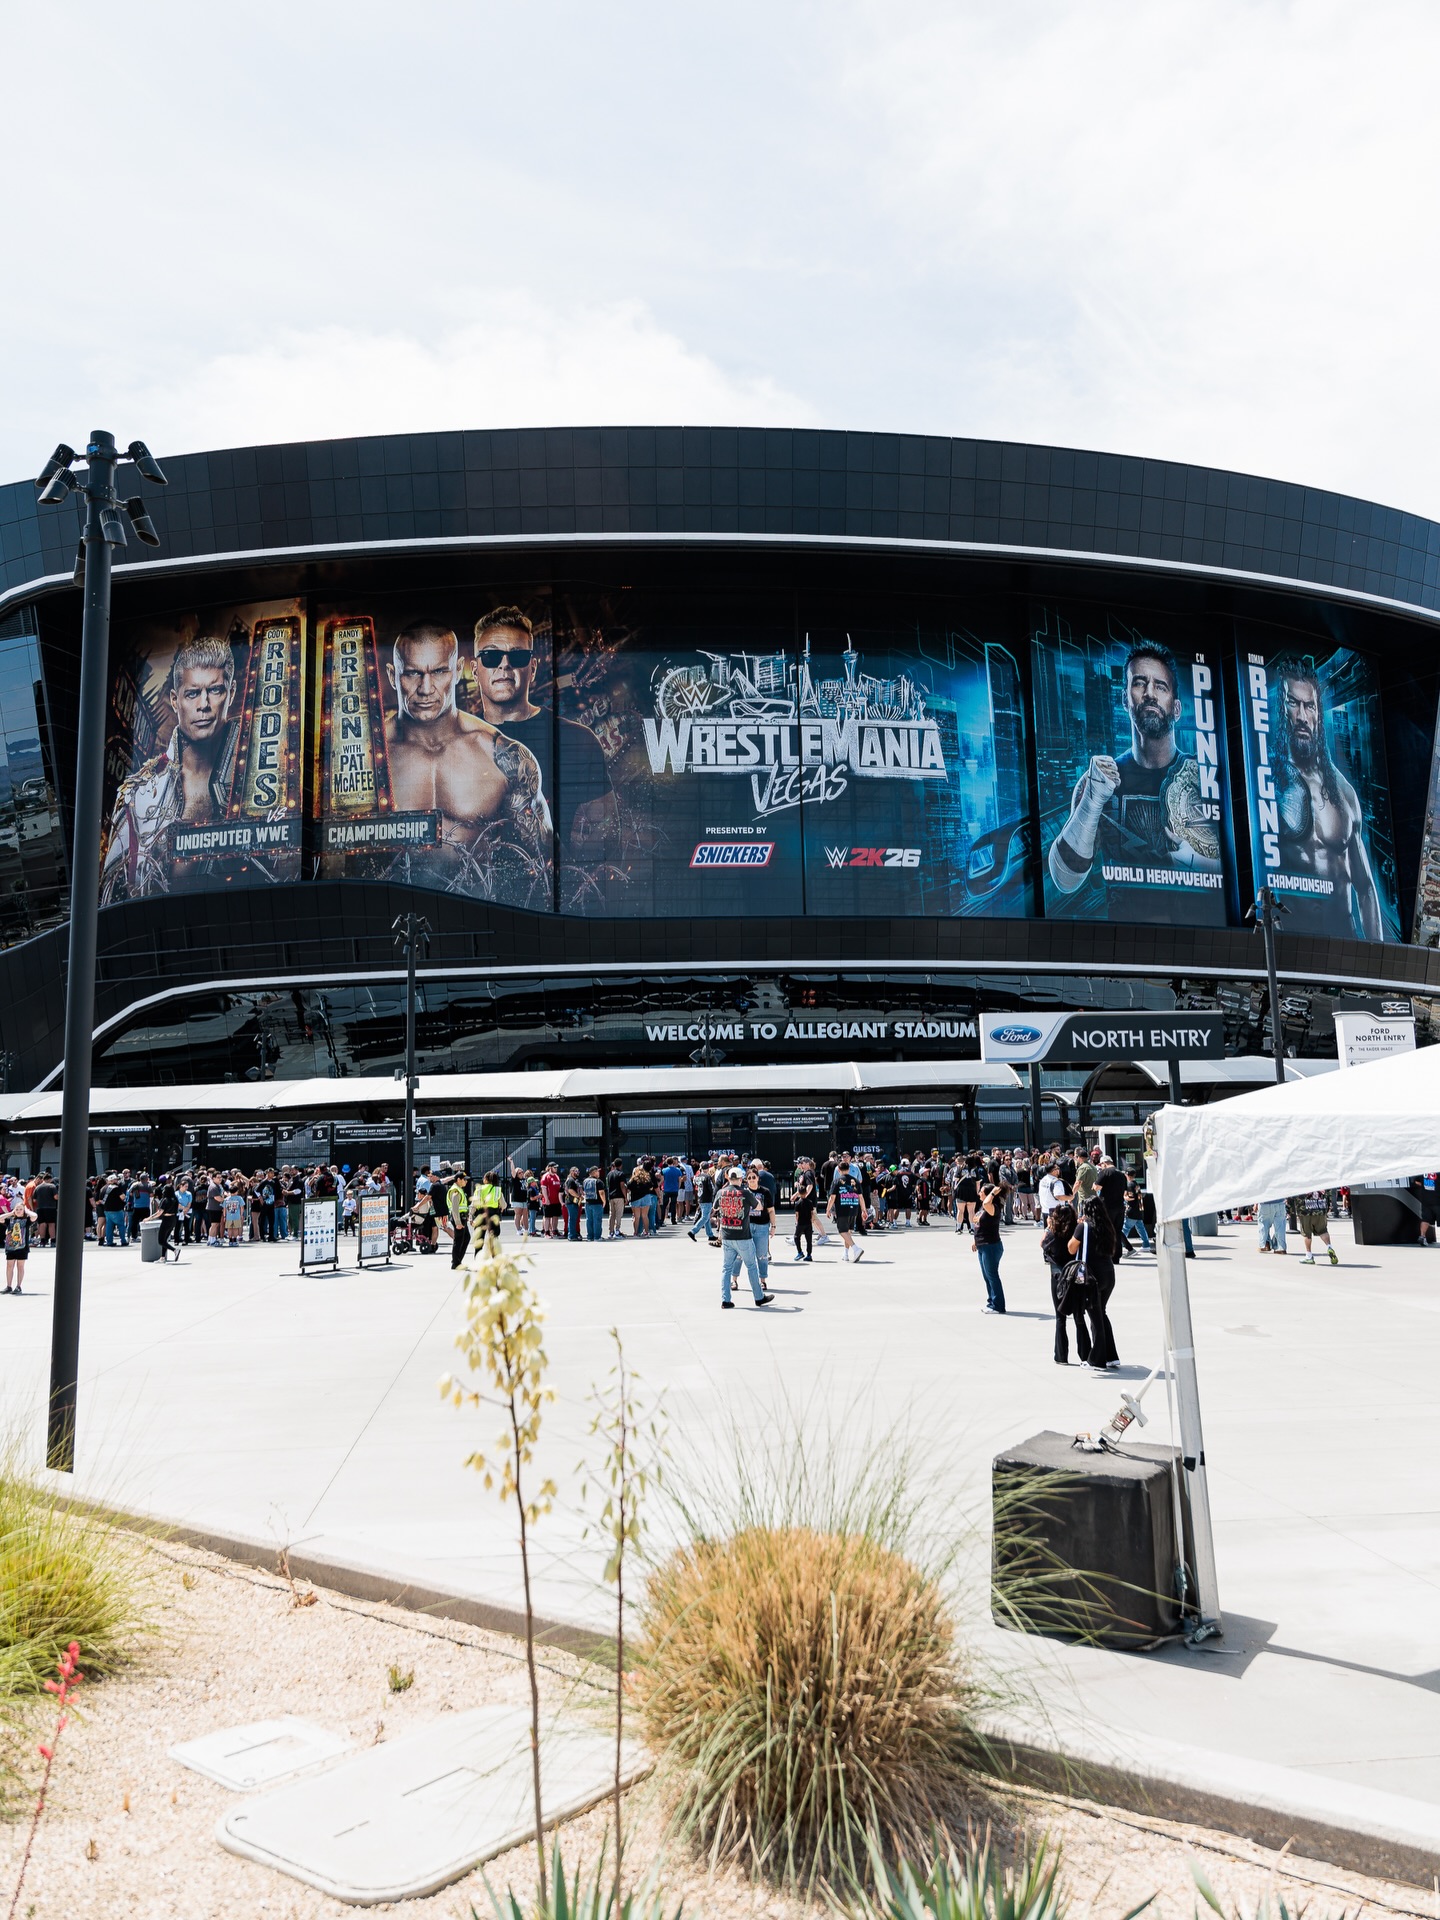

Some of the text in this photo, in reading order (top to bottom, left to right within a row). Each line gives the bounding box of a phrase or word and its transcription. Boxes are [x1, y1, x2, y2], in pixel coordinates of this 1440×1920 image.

[267, 629, 285, 639] CODY
[338, 629, 360, 639] RANDY
[1195, 652, 1205, 664] CM
[1248, 653, 1265, 666] ROMAN
[340, 640, 362, 740] ORTON
[253, 641, 285, 808] RHODES
[1191, 664, 1220, 800] PUNK
[342, 744, 362, 754] WITH
[340, 753, 366, 772] PAT
[1248, 665, 1281, 868] REIGNS
[333, 770, 375, 794] McAFEE
[751, 760, 848, 815] VEGAS
[1202, 803, 1221, 821] VS
[176, 825, 289, 851] UNDISPUTED WWE
[328, 822, 429, 844] CHAMPIONSHIP
[705, 827, 768, 835] PRESENTED BY
[696, 846, 769, 864] SNICKERS
[849, 848, 922, 867] 2K26
[1101, 865, 1224, 889] WORLD HEAVYWEIGHT
[1266, 873, 1335, 894] CHAMPIONSHIP
[646, 1021, 977, 1042] WELCOME TO ALLEGIANT STADIUM
[1000, 1028, 1212, 1049] Ford NORTH ENTRY
[190, 1134, 195, 1142] 9
[283, 1131, 288, 1139] 9
[317, 1130, 323, 1138] 8
[416, 1127, 422, 1135] 8
